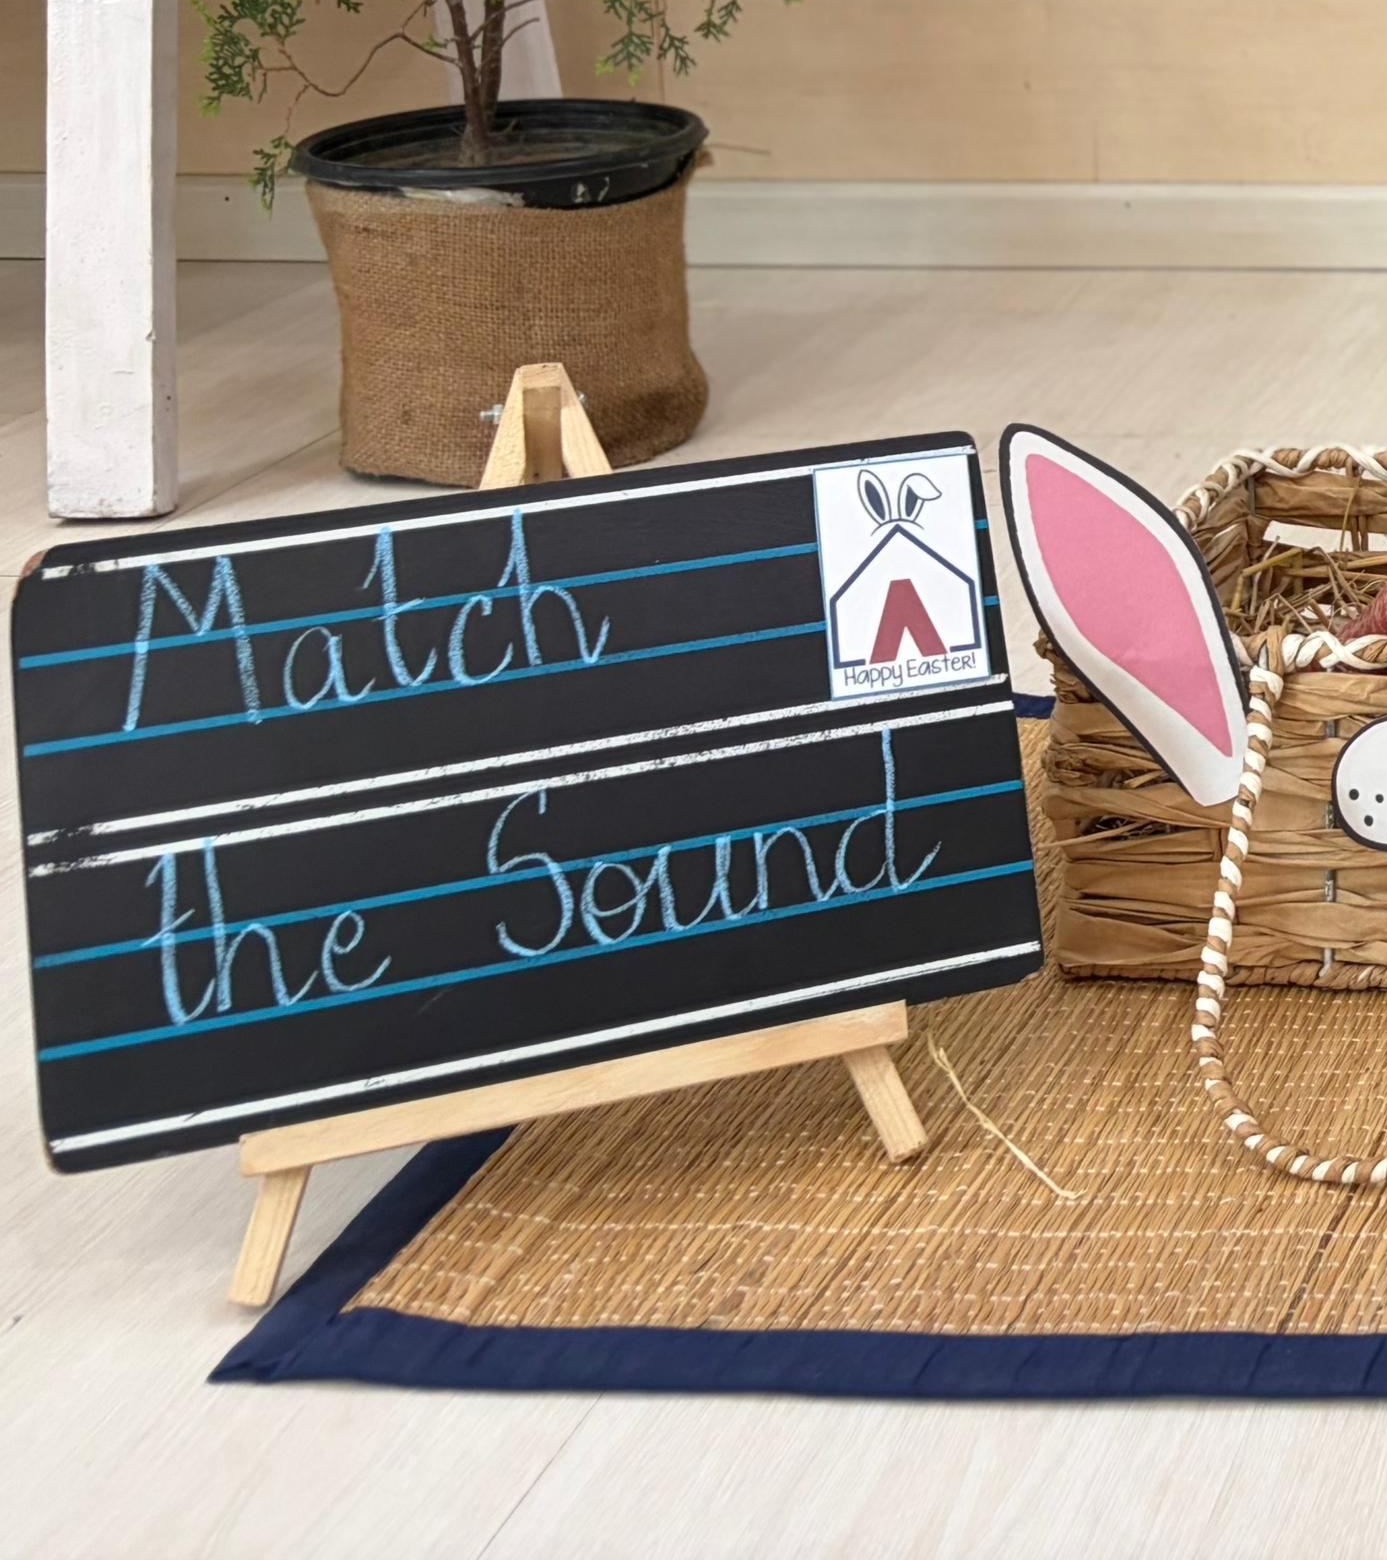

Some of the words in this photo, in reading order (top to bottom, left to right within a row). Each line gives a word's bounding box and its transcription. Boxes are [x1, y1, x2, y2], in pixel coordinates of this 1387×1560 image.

[122, 507, 610, 733] Match
[843, 663, 904, 688] Happy
[906, 651, 976, 678] Easter!
[487, 727, 941, 956] Sound
